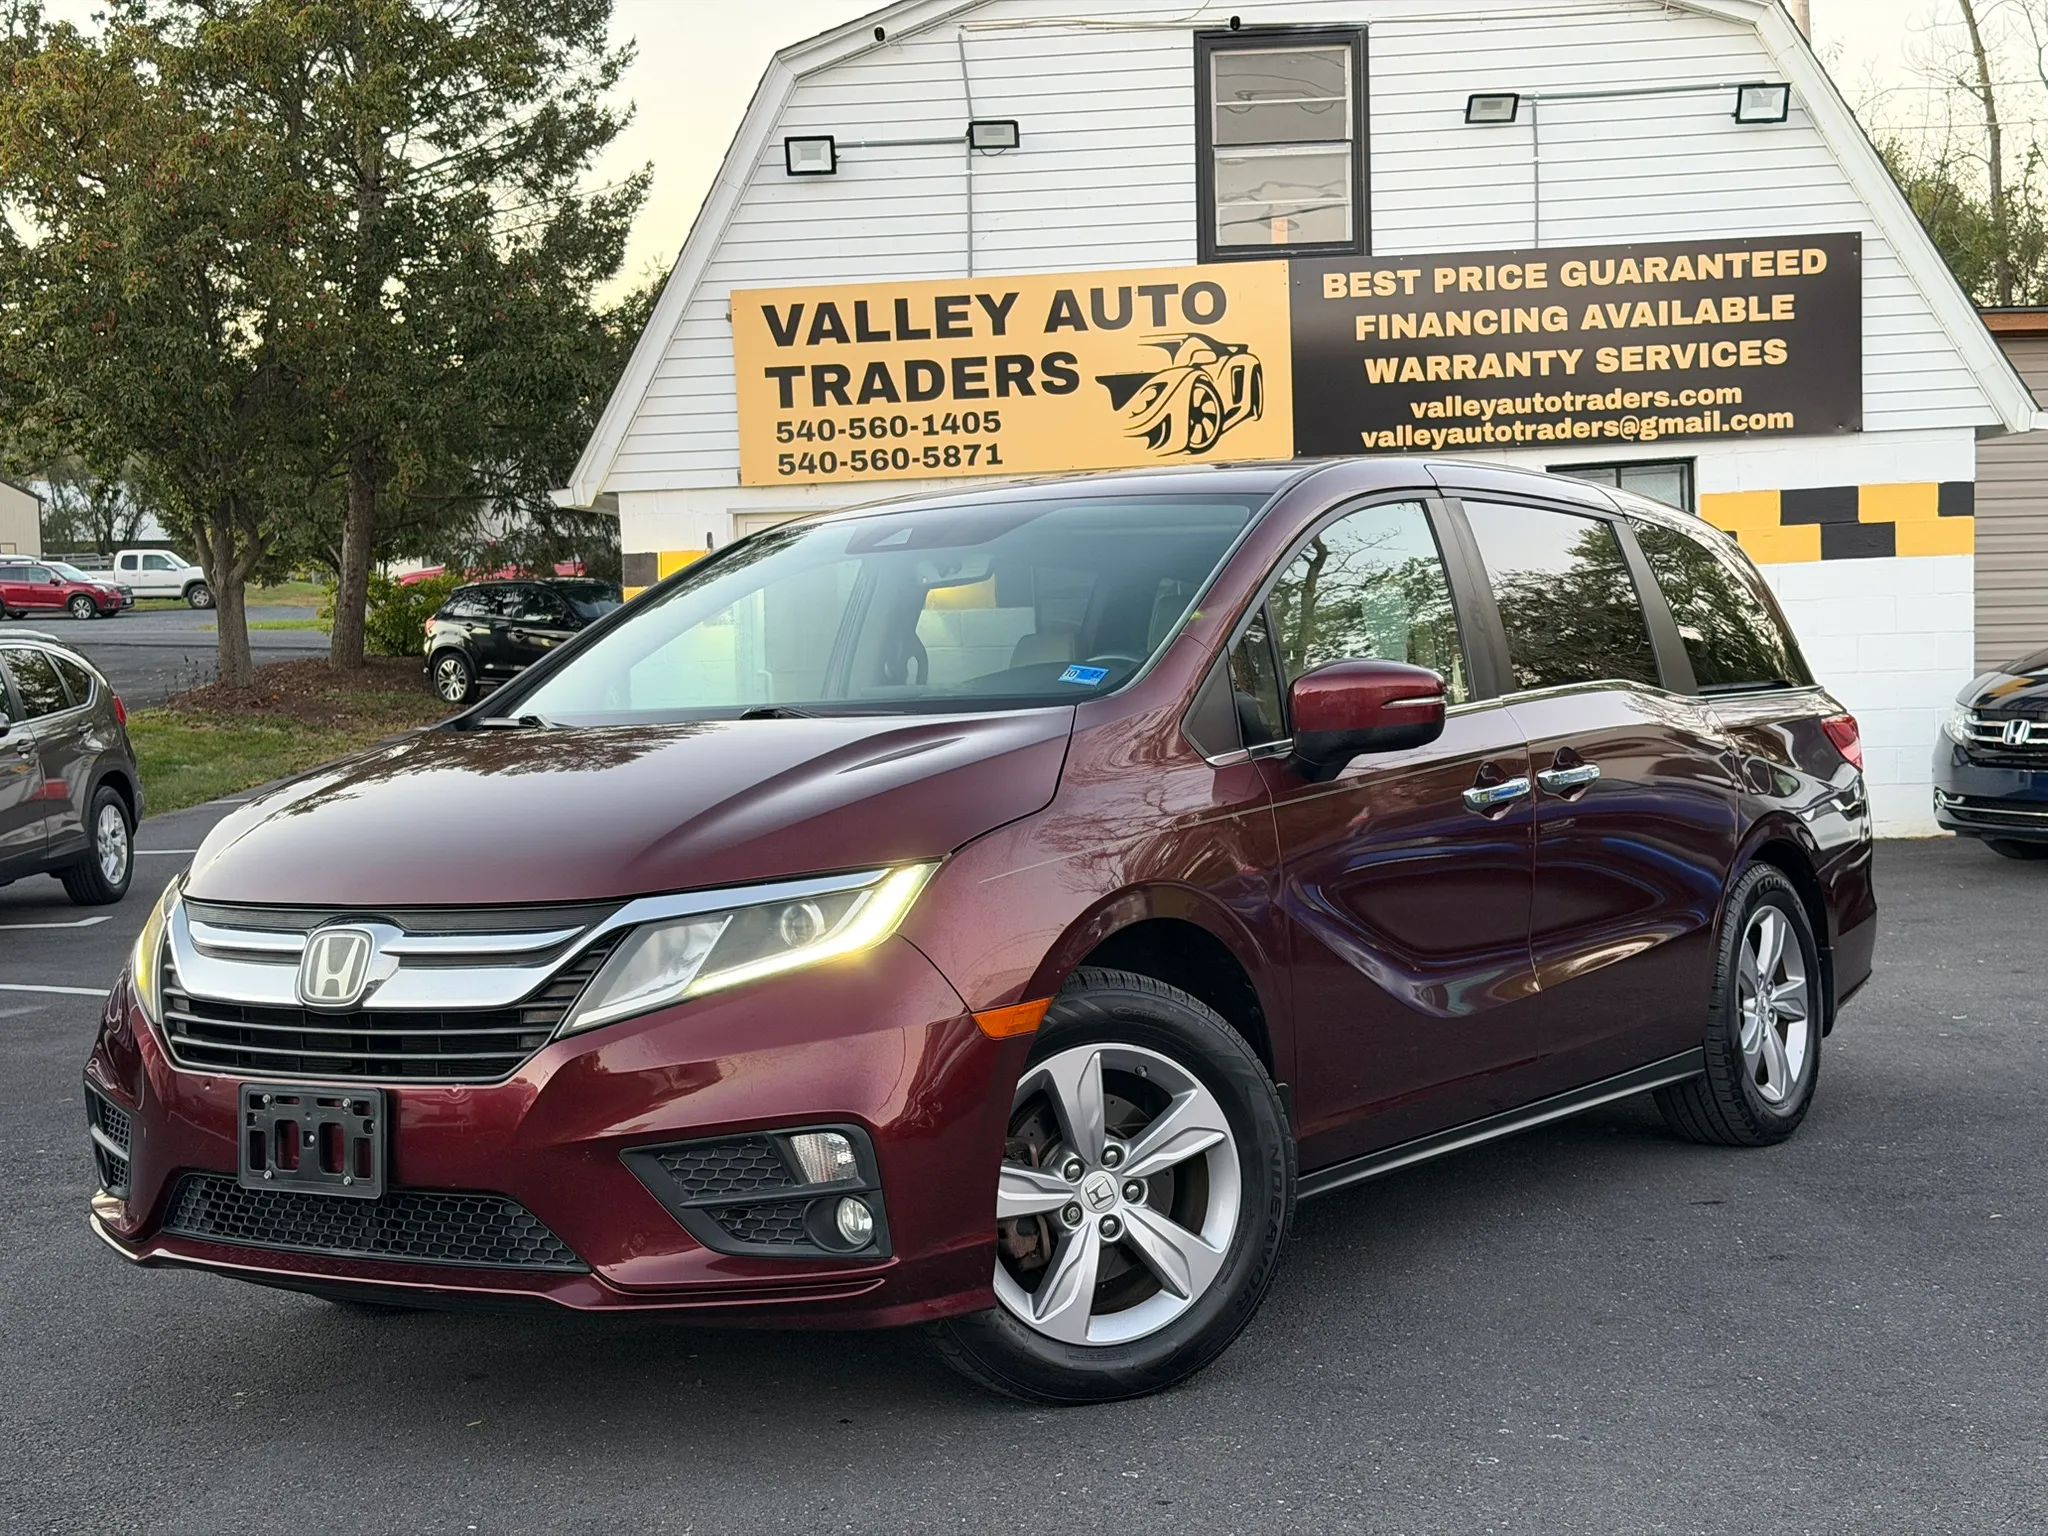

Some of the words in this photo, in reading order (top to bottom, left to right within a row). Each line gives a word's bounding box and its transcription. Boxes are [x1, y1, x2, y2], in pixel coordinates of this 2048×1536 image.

[1322, 269, 1422, 299] BEST
[1434, 262, 1548, 294] PRICE
[1559, 248, 1828, 288] GUARANTEED
[761, 291, 1020, 348] VALLEY
[1043, 281, 1228, 335] AUTO
[1355, 305, 1569, 341] FINANCING
[1580, 293, 1796, 331] AVAILABLE
[764, 351, 1080, 409] TRADERS
[1364, 349, 1584, 384] WARRANTY
[1595, 338, 1788, 374] SERVICES
[776, 410, 1002, 443] 540-560-1405
[1410, 387, 1743, 420] valleyautotraders.com
[1361, 408, 1795, 451] valleyautotraders@gmail.com
[777, 443, 1004, 476] 540-560-5871
